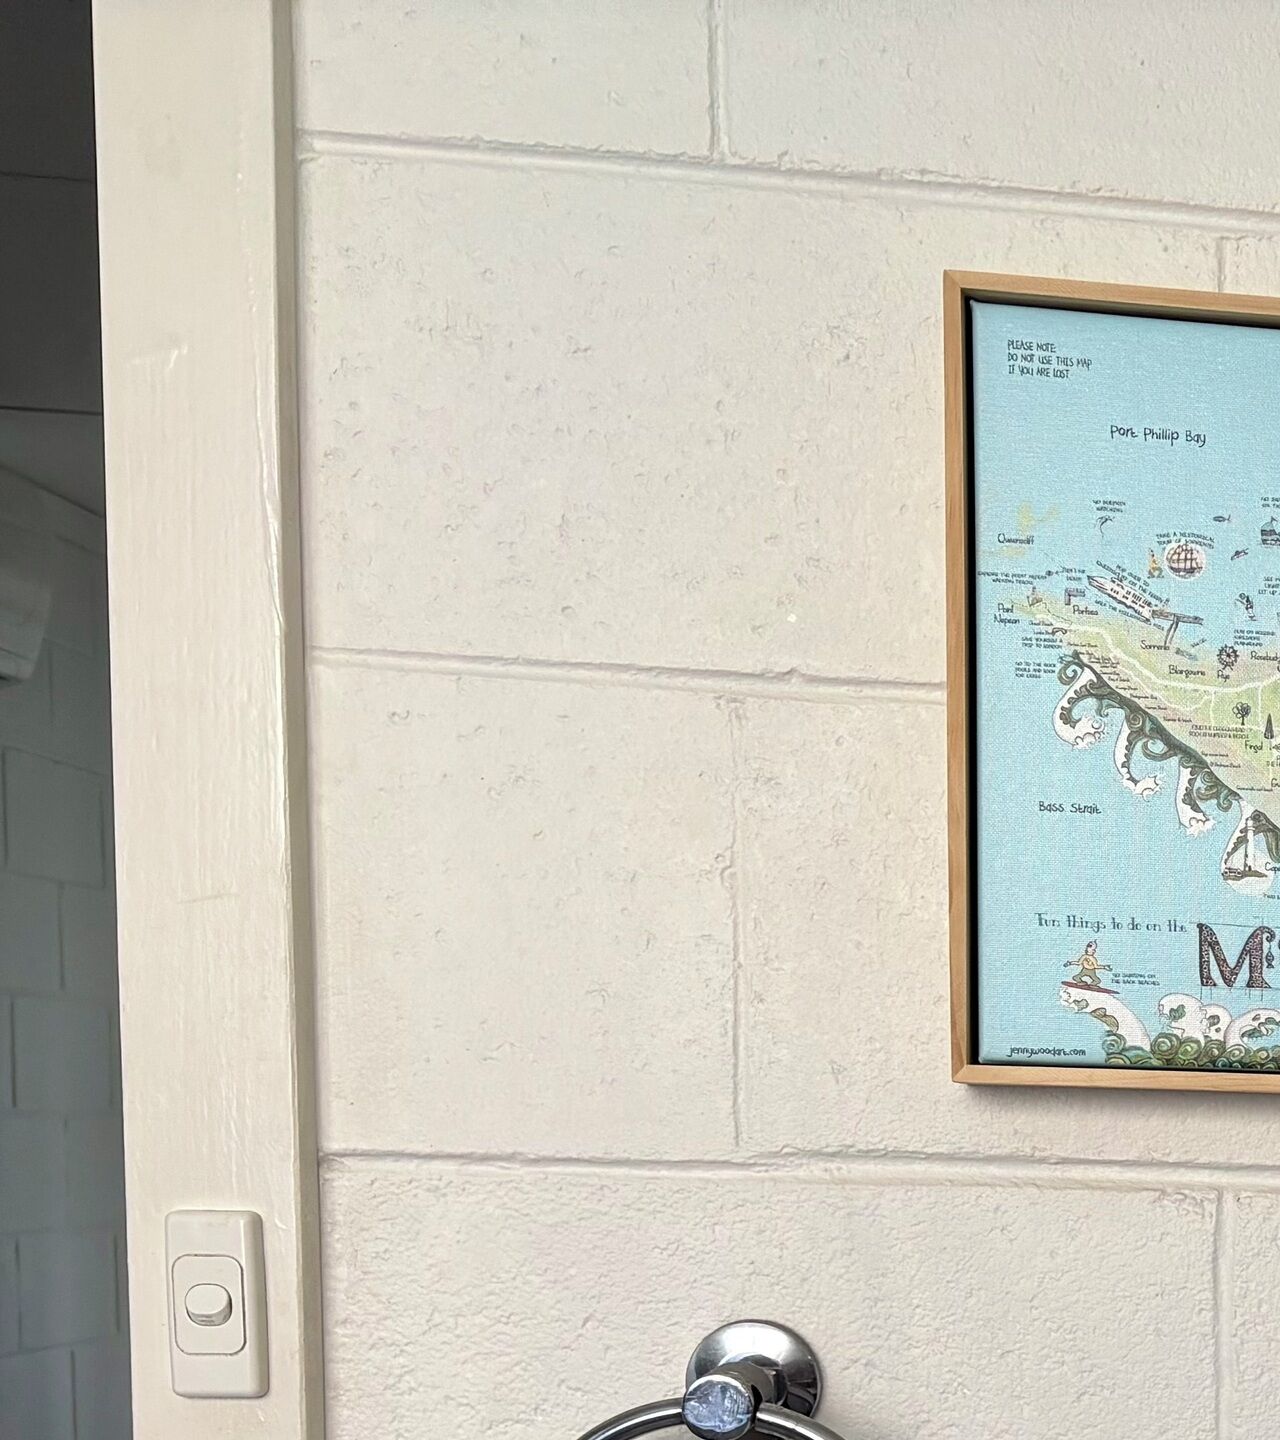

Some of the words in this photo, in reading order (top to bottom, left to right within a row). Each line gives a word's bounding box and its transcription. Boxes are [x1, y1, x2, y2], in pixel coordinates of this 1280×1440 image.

[1007, 339, 1034, 351] PLEASE
[1007, 352, 1018, 362] DO
[1021, 353, 1035, 363] NOT
[1038, 355, 1053, 365] USE
[1056, 356, 1074, 367] THIS
[1076, 358, 1093, 371] MAP
[1008, 365, 1015, 374] IF
[1018, 365, 1034, 376] YOU
[1036, 367, 1051, 378] ARE
[1053, 368, 1070, 379] LOST
[1143, 427, 1179, 446] Phillip
[1185, 429, 1206, 448] Bay
[997, 603, 1014, 614] Point
[1072, 604, 1098, 616] Portsea
[993, 614, 1020, 626] Nepean
[1039, 800, 1065, 813] Bass
[1070, 803, 1102, 815] Strait
[1264, 861, 1280, 875] Cape
[1034, 912, 1061, 928] Fun
[1066, 914, 1107, 933] things
[1111, 917, 1123, 930] to
[1127, 917, 1142, 931] do
[1146, 922, 1162, 932] on
[1167, 919, 1187, 933] the
[1006, 1046, 1086, 1058] jennywoodart.com
